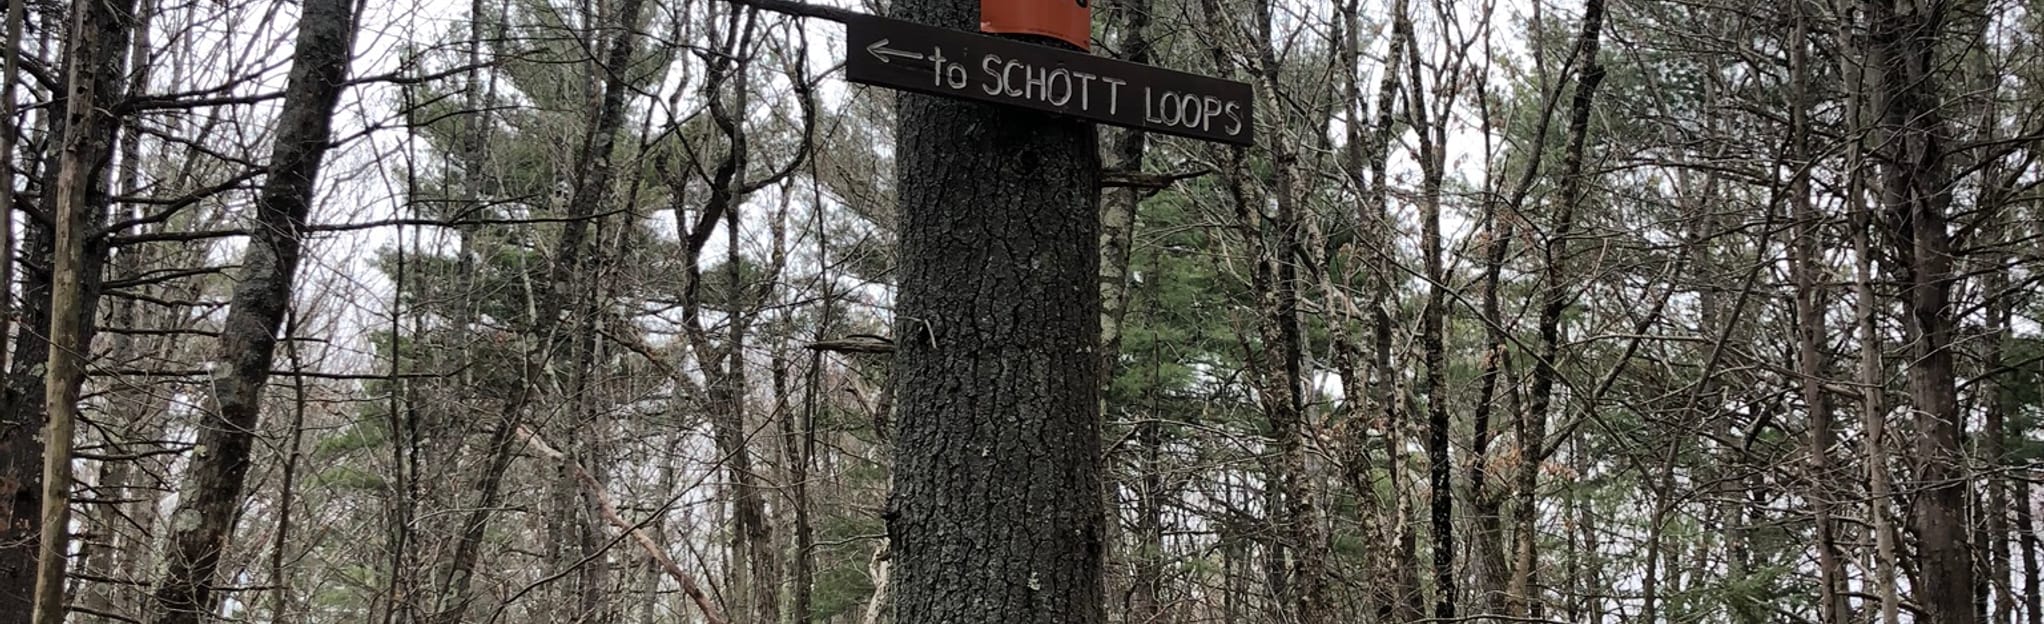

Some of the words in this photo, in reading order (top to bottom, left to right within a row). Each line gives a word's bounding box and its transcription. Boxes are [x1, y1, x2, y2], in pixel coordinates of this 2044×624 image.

[928, 46, 967, 89] to
[982, 54, 1126, 116] SCHOTT
[1145, 87, 1242, 136] LOOPS
